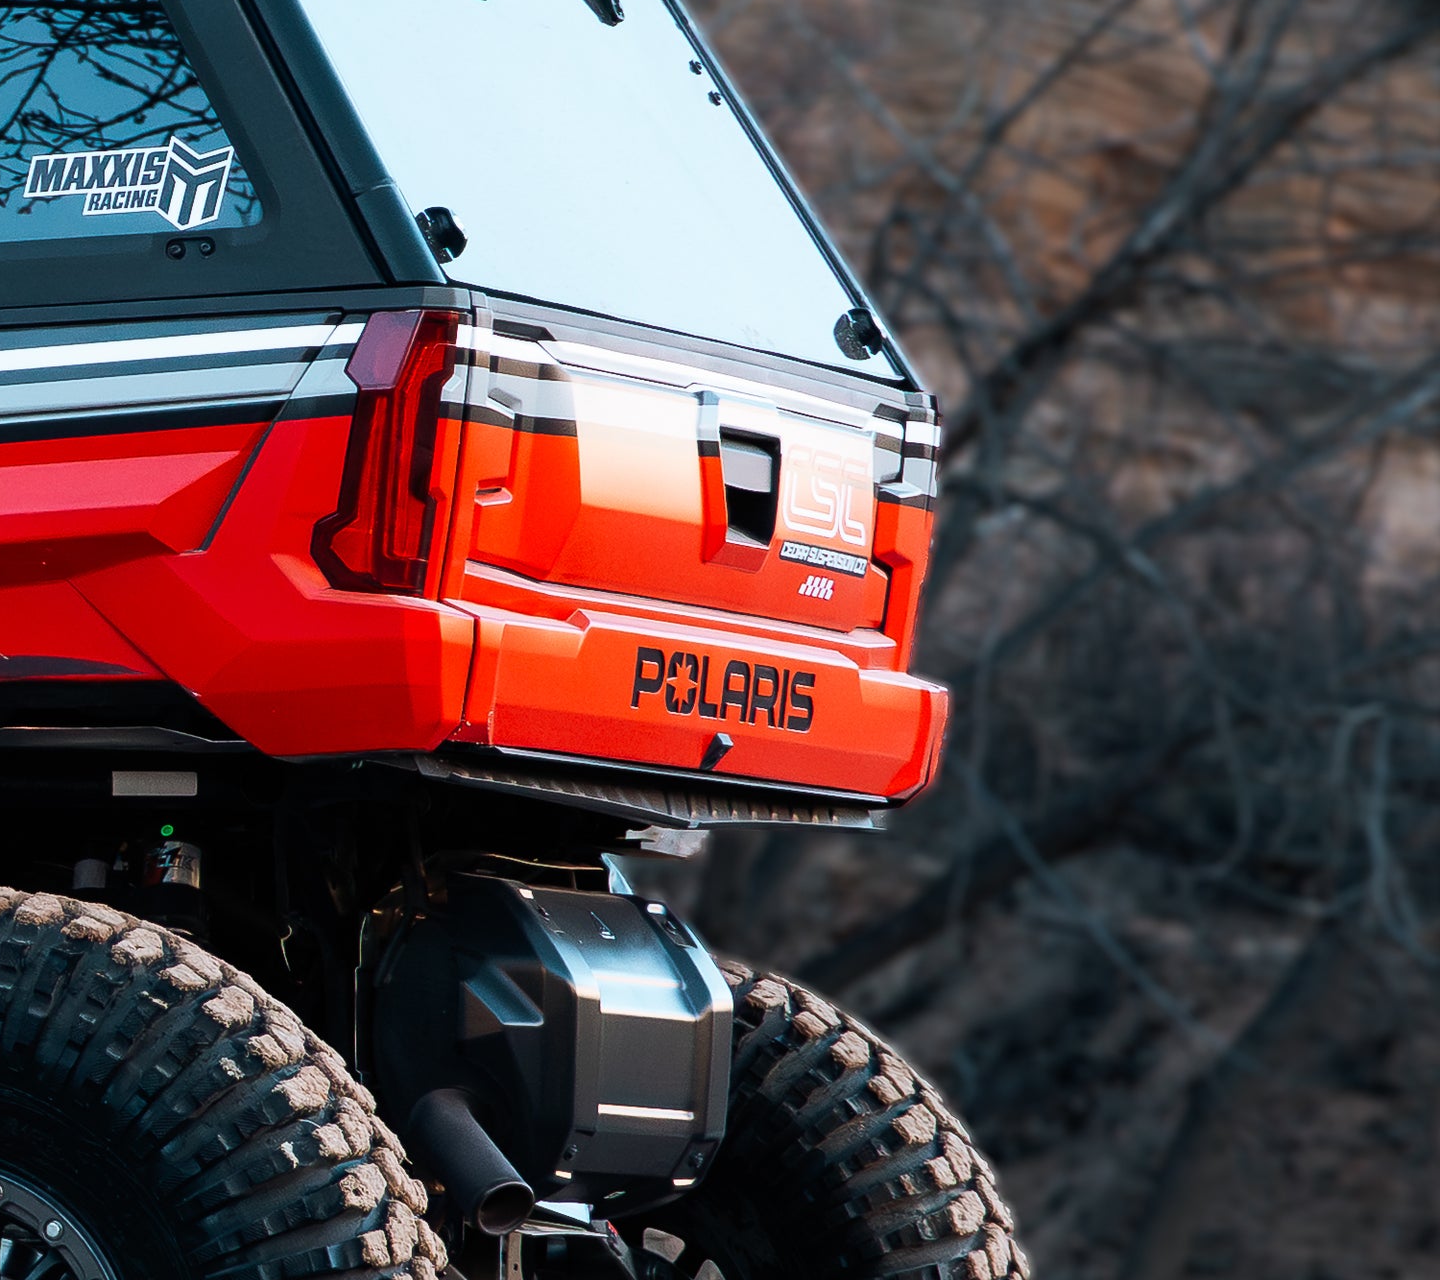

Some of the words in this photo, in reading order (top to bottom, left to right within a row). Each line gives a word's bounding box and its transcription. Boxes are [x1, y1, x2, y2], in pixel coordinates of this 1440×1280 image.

[30, 150, 170, 194] MAXXIS
[87, 189, 159, 212] RACING
[630, 646, 817, 733] POLARIS
